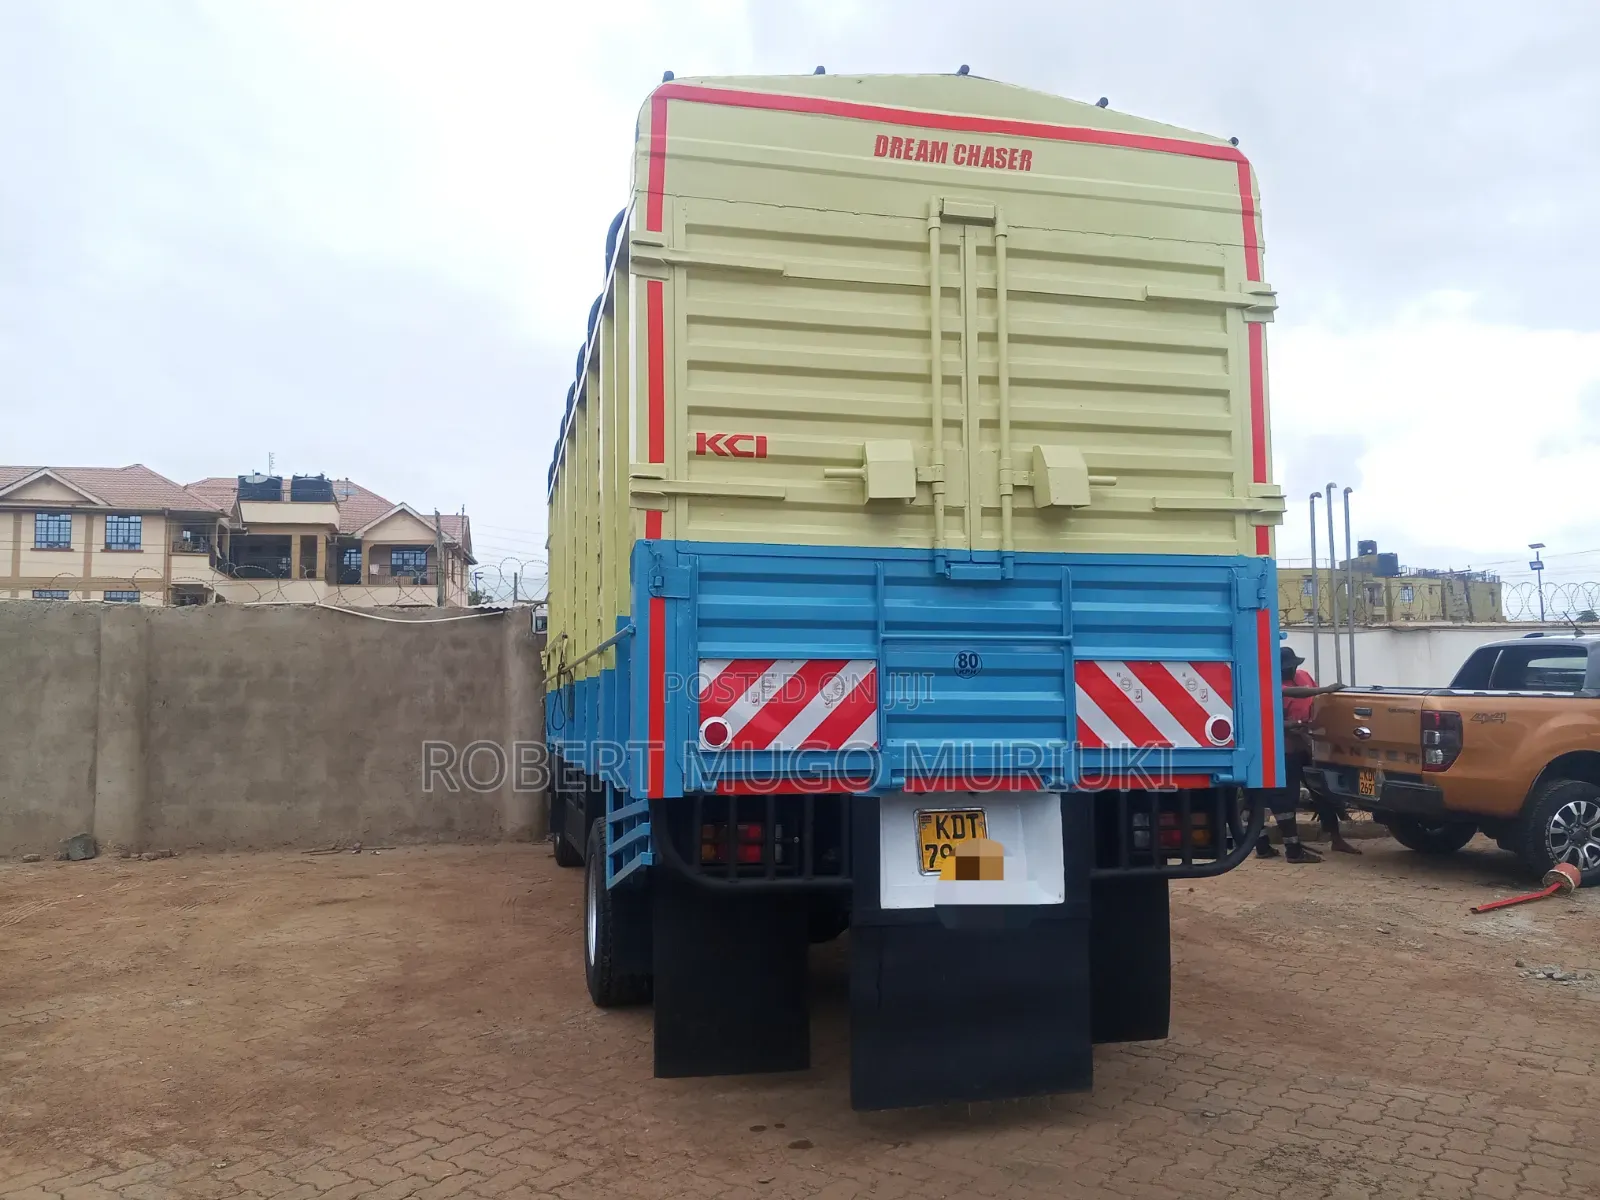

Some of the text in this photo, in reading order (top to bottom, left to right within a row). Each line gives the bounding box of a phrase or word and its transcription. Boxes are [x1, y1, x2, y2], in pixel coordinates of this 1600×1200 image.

[874, 134, 1032, 171] DREAM CHASER
[696, 432, 767, 458] KCI
[958, 653, 979, 668] 80
[935, 813, 979, 839] KDT
